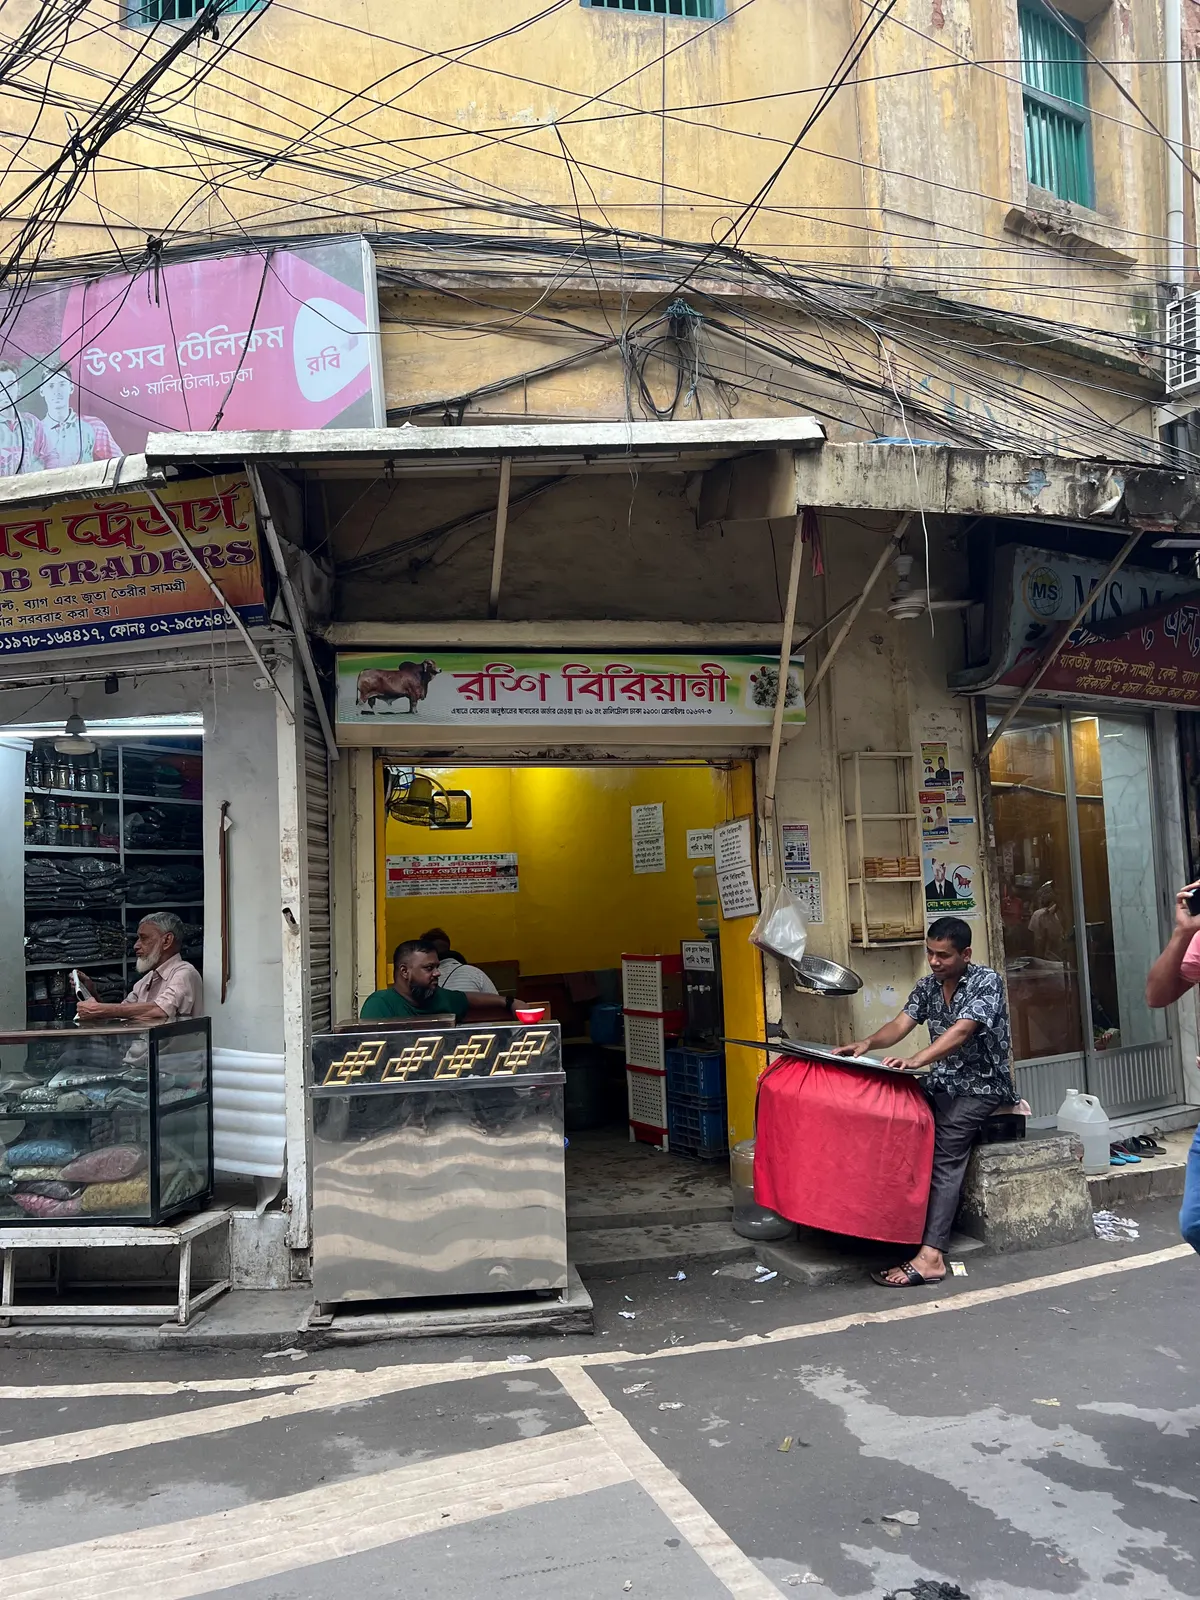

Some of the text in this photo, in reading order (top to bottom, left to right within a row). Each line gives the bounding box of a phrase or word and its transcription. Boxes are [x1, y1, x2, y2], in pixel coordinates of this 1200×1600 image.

[84, 325, 285, 376] উৎসব টেলিকম
[306, 346, 341, 376] রবি
[119, 385, 140, 398] ৬৯
[61, 481, 250, 552] ট্রেডার্স
[39, 540, 256, 588] TRADERS
[23, 597, 48, 611] ব্যাগ
[53, 595, 78, 606] এবং
[81, 590, 107, 605] জুতা
[109, 583, 146, 600] তৈরীর
[151, 579, 186, 594] সামগ্রী
[1032, 582, 1058, 600] MS
[17, 610, 63, 626] সরবরাহ
[67, 607, 89, 620] করা
[93, 605, 110, 617] হয়
[109, 622, 146, 637] ফোনঃ
[1060, 651, 1093, 671] যাবতীয়
[1094, 656, 1129, 676] গার্মেন্টস
[561, 663, 731, 702] বিরিয়ানী
[1076, 673, 1112, 690] পাইকারী
[1112, 681, 1121, 691] ও
[428, 854, 508, 862] ENTERPRISE
